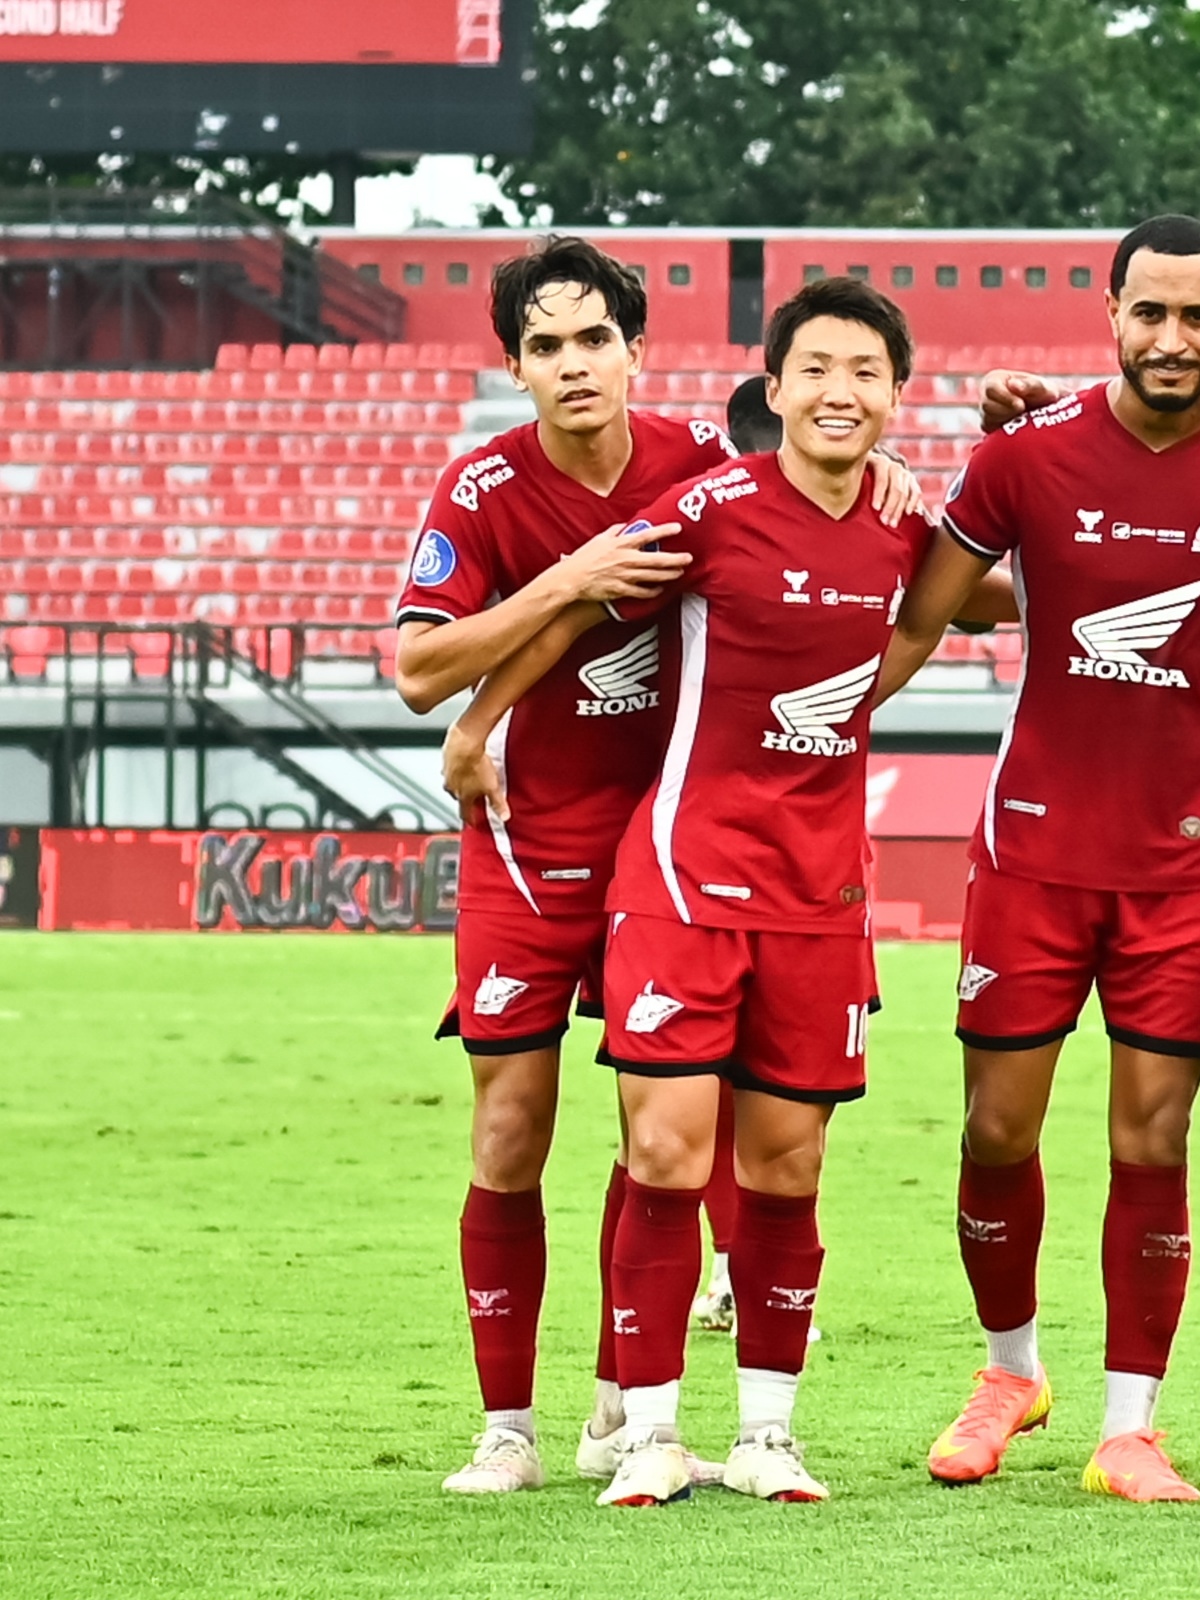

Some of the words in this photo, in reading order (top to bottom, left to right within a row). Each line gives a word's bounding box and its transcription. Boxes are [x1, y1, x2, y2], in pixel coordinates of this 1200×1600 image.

[60, 0, 125, 37] HALF
[1032, 403, 1083, 429] Pintar
[1067, 656, 1191, 689] HONDA
